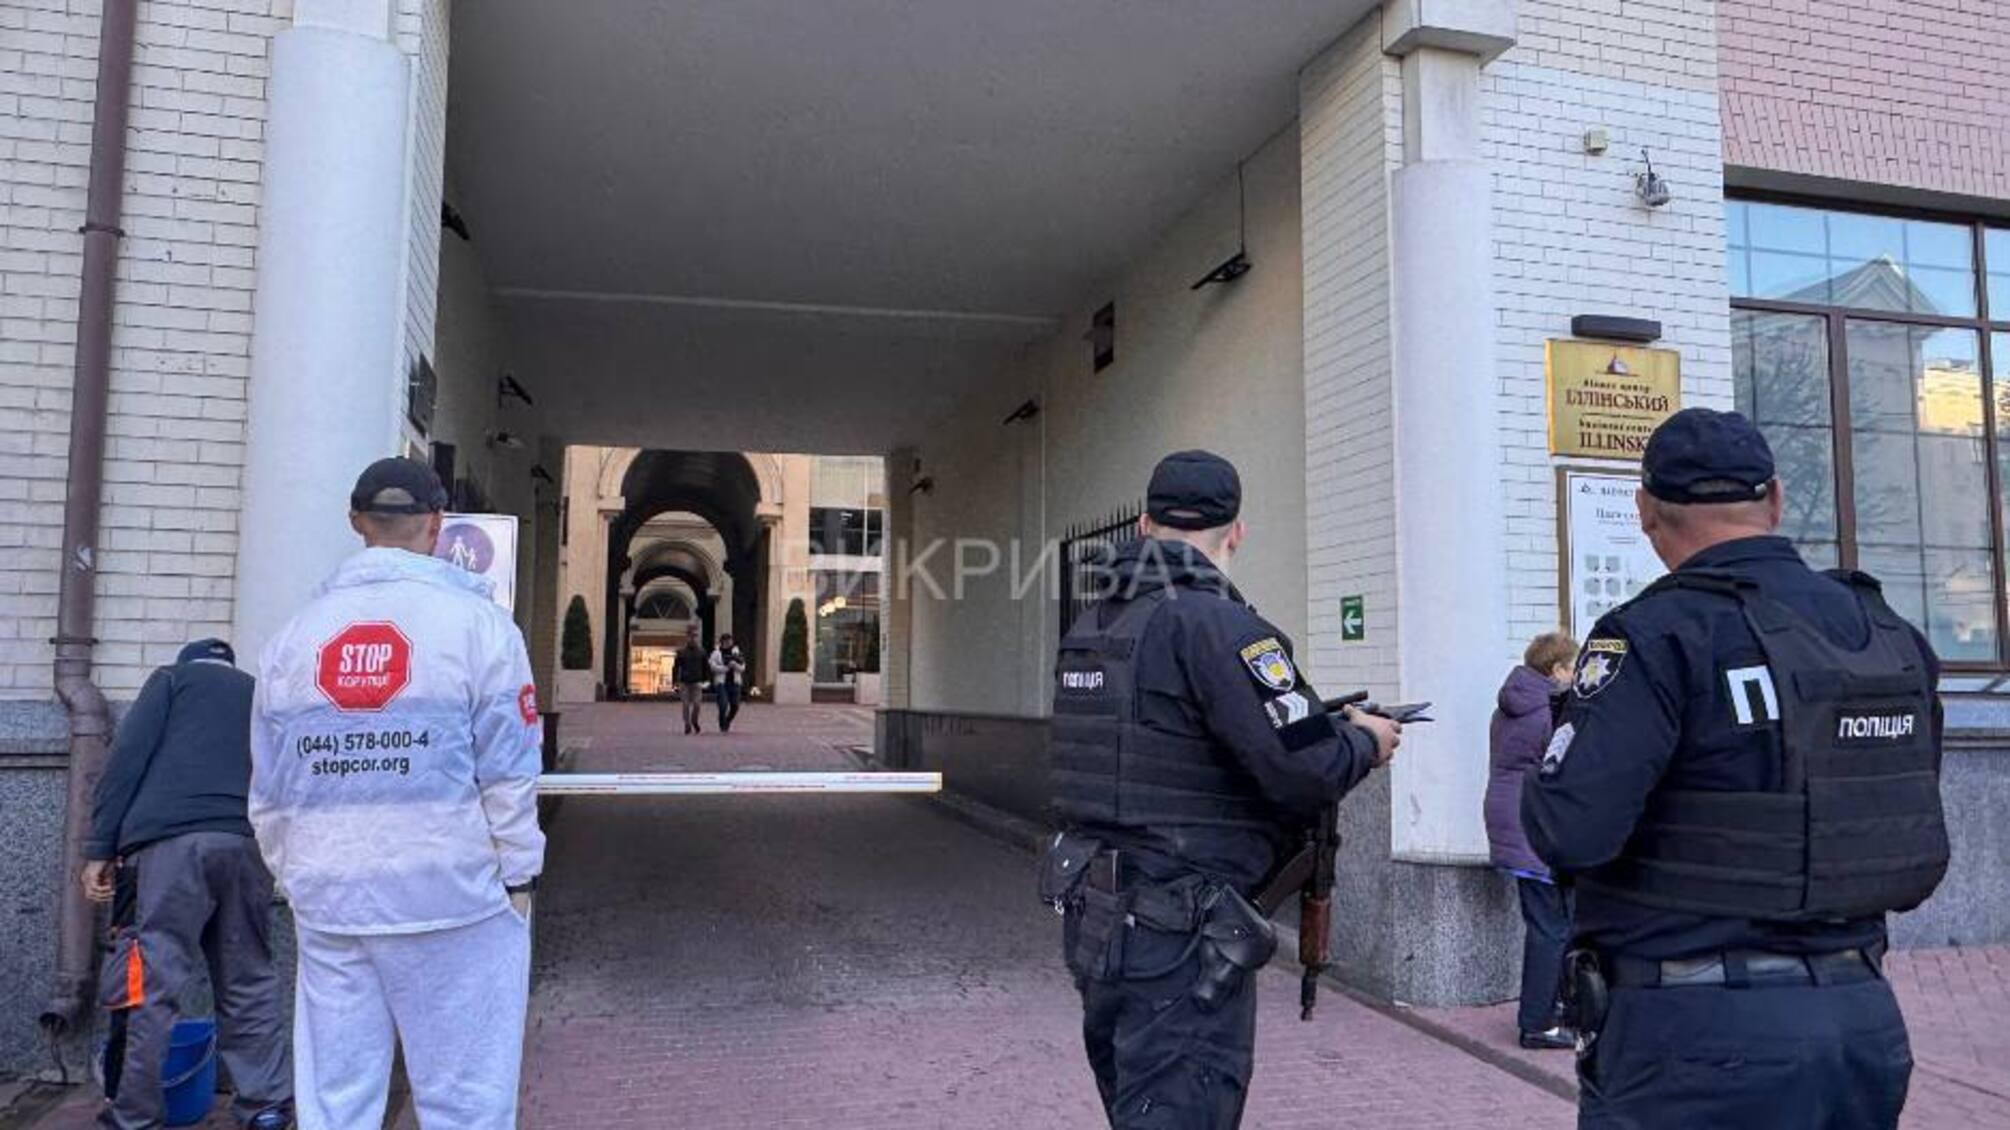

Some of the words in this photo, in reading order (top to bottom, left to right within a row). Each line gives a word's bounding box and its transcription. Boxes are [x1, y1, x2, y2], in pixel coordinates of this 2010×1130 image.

[1566, 388, 1669, 412] ІЛЛІНСЬКИЙ
[1578, 431, 1647, 452] ILLINSK
[339, 643, 393, 673] STOP
[1063, 671, 1103, 690] ПОЛІЦІЯ
[1839, 714, 1914, 739] ПОЛІЦІЯ
[296, 735, 338, 757] (044)
[344, 731, 429, 751] 578-000-4
[312, 755, 410, 777] stopcor.org
